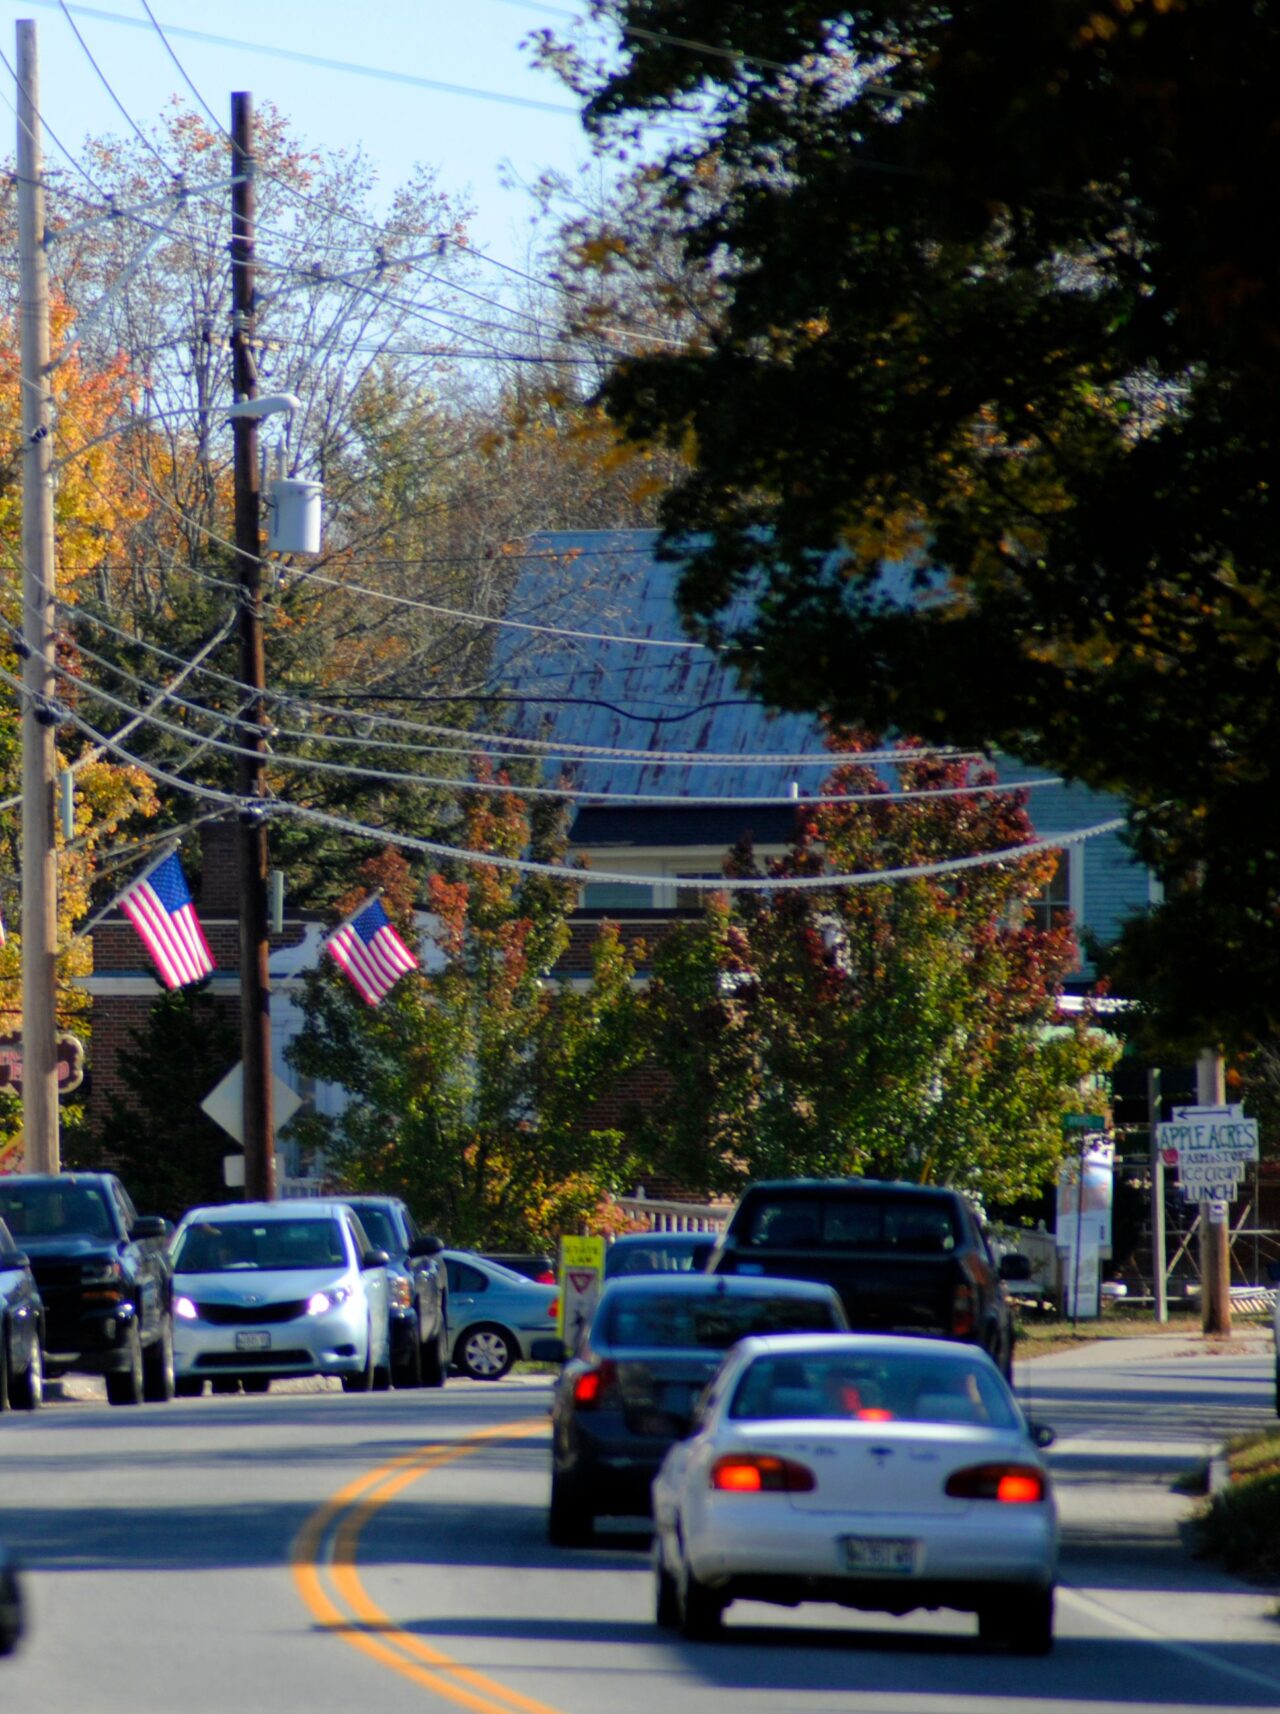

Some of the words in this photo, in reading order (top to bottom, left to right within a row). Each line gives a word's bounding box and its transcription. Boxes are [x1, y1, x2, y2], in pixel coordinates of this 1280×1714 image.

[1160, 1124, 1207, 1150] APPLE
[1208, 1123, 1257, 1149] ACRES
[1183, 1183, 1234, 1201] LUNCH
